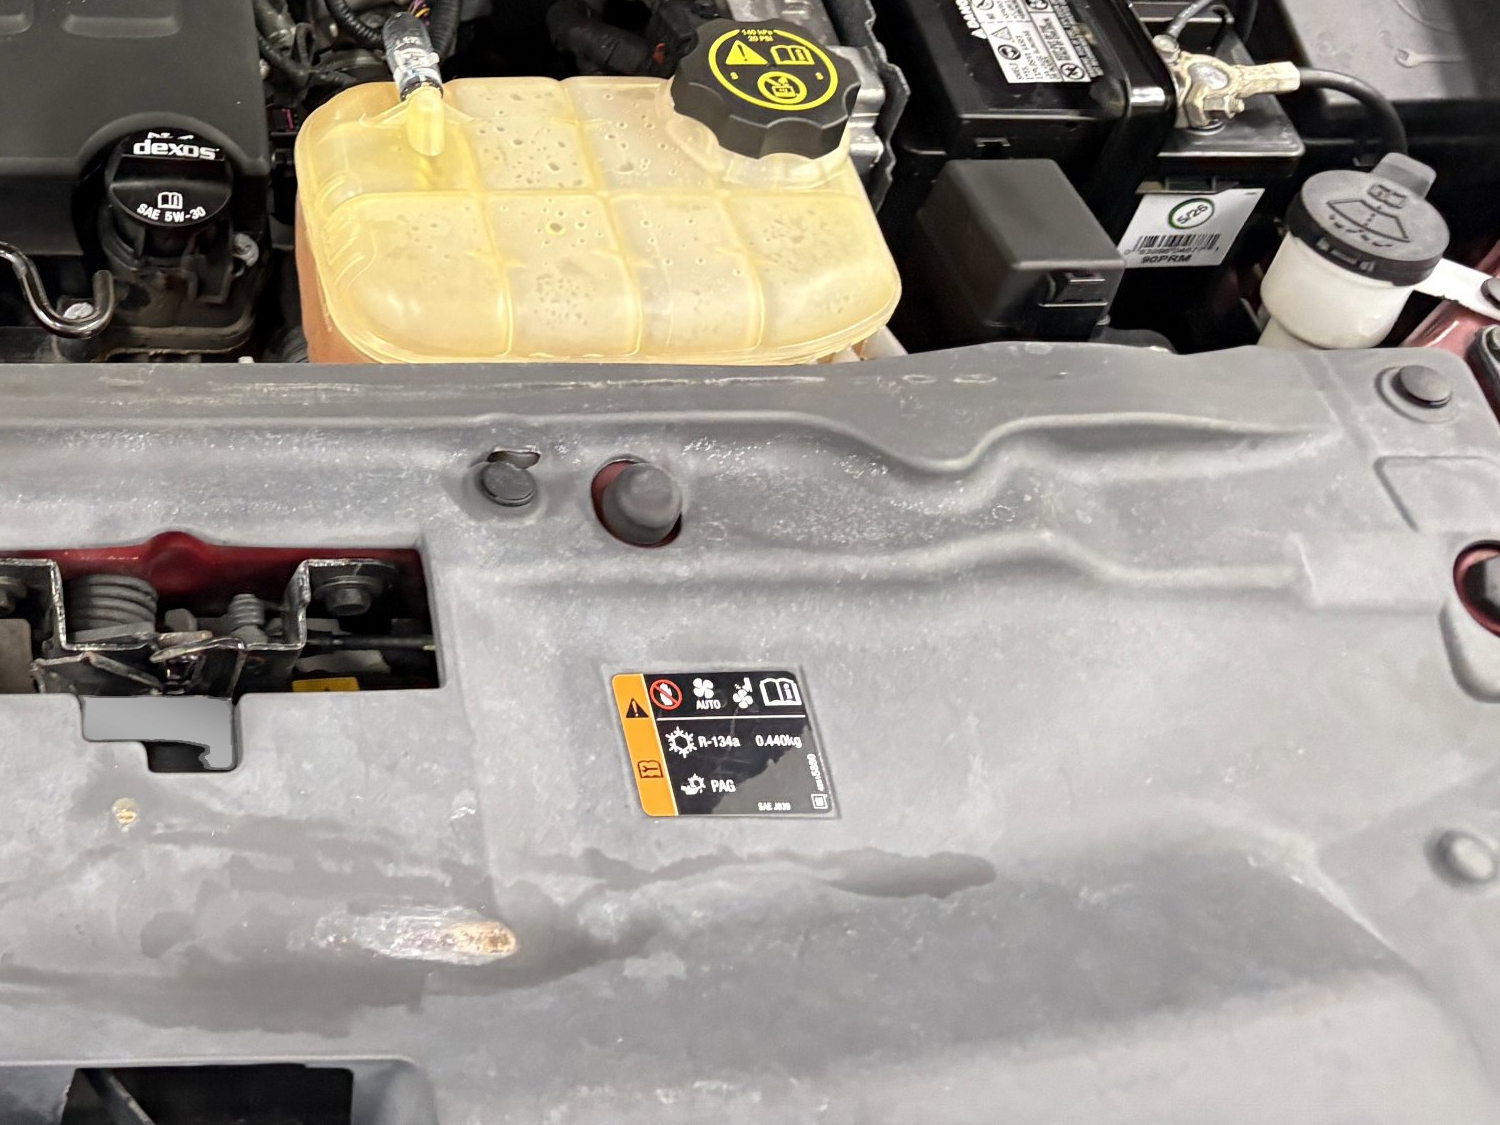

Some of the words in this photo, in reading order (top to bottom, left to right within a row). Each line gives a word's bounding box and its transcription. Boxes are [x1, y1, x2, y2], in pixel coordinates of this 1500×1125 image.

[133, 139, 216, 161] dexos
[137, 203, 161, 221] SAE
[164, 206, 206, 223] 5W-30
[696, 699, 721, 710] AUTO
[698, 735, 741, 748] R-134a
[755, 735, 803, 749] 0.440kg
[711, 779, 736, 793] PAG
